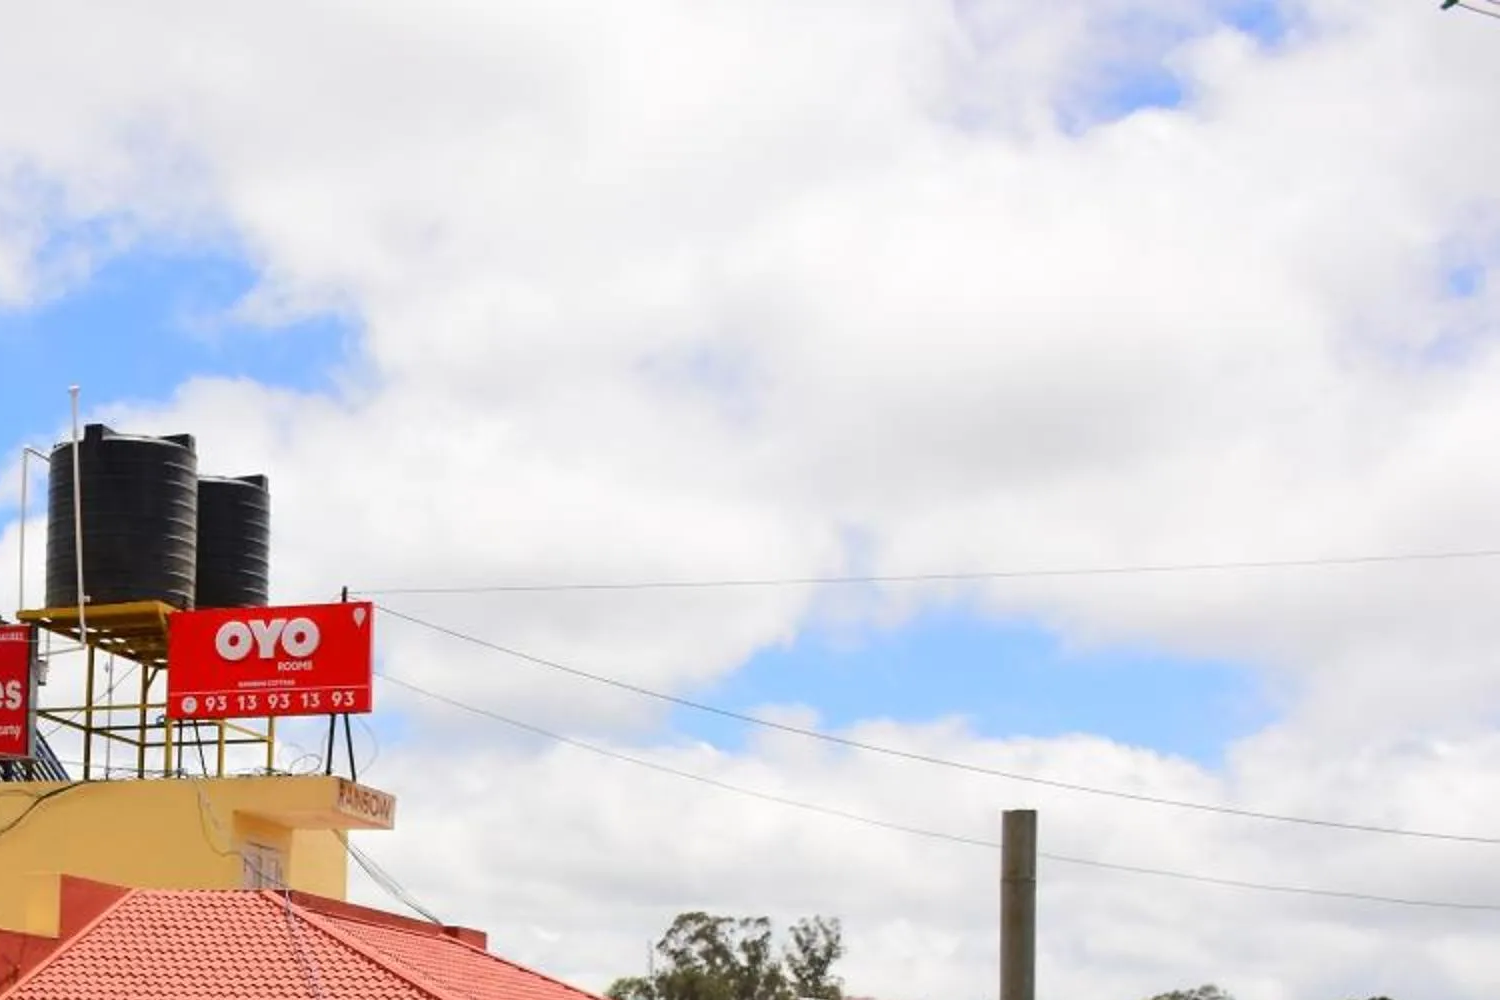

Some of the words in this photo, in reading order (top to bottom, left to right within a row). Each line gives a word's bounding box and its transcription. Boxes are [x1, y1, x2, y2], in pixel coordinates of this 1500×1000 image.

[215, 617, 321, 661] OYO
[277, 660, 313, 671] ROOMS
[205, 696, 227, 712] 93
[238, 695, 257, 711] 13
[268, 692, 290, 708] 93
[300, 691, 320, 708] 13
[332, 691, 355, 707] 93
